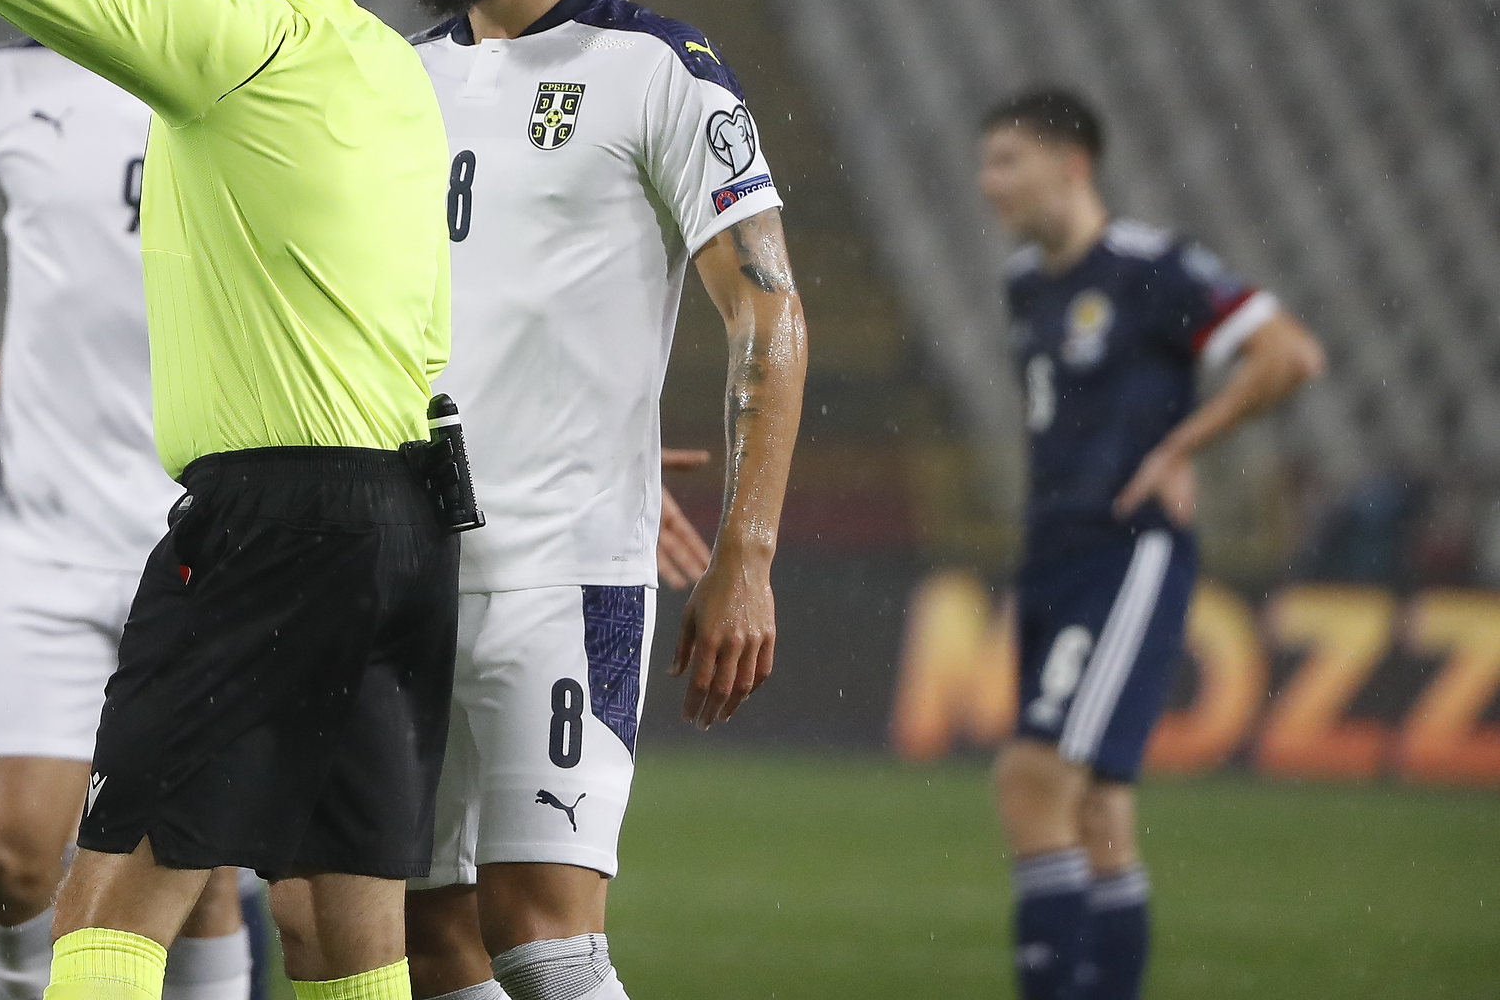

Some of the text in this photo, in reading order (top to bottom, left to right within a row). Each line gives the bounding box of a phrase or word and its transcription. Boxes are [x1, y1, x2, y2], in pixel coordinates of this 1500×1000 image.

[540, 83, 582, 93] СРБИЈА
[446, 149, 476, 243] 8
[548, 677, 584, 769] 8
